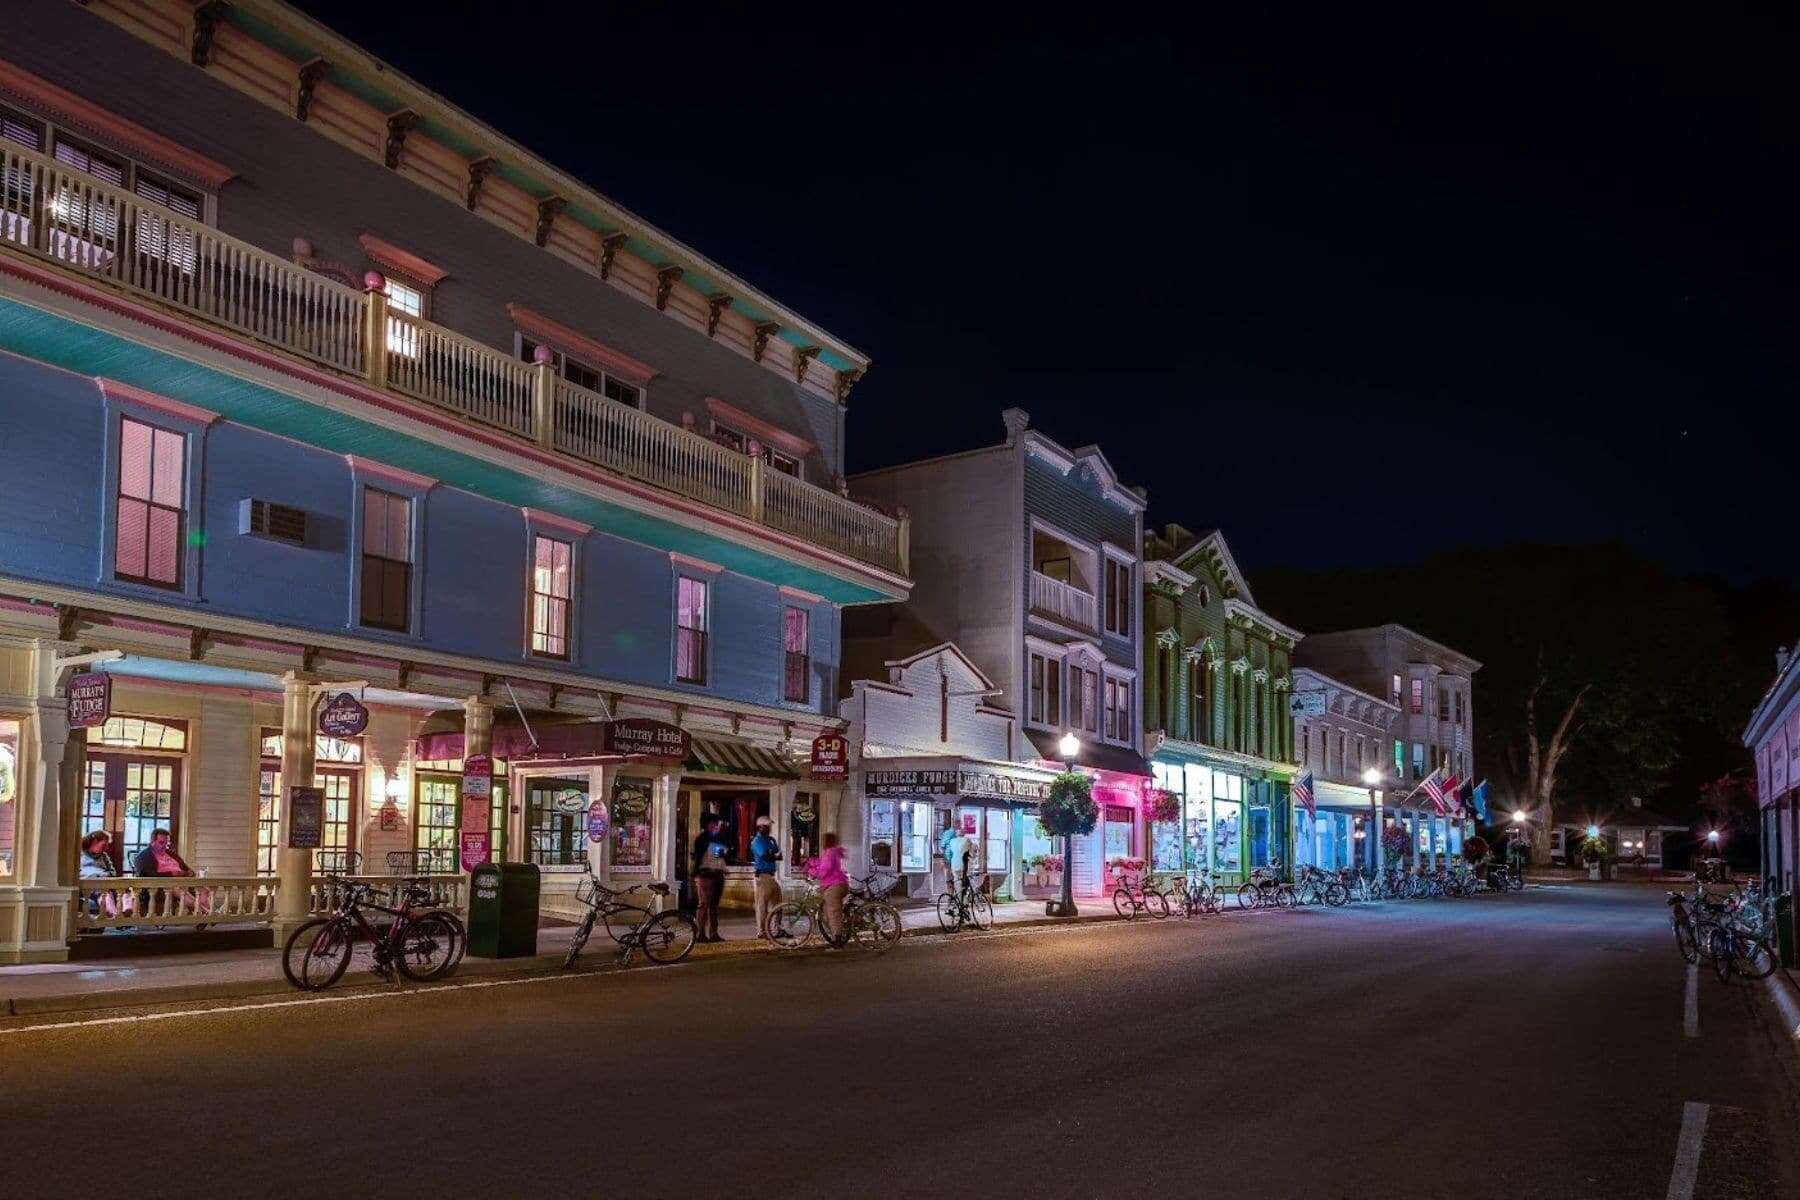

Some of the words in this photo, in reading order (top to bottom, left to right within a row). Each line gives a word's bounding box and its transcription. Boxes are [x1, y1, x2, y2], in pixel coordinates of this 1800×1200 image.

[71, 698, 104, 718] FUDGE
[614, 724, 654, 743] Murray
[657, 728, 682, 744] Hotel
[817, 738, 841, 751] 3-D
[922, 771, 956, 784] FUDGE
